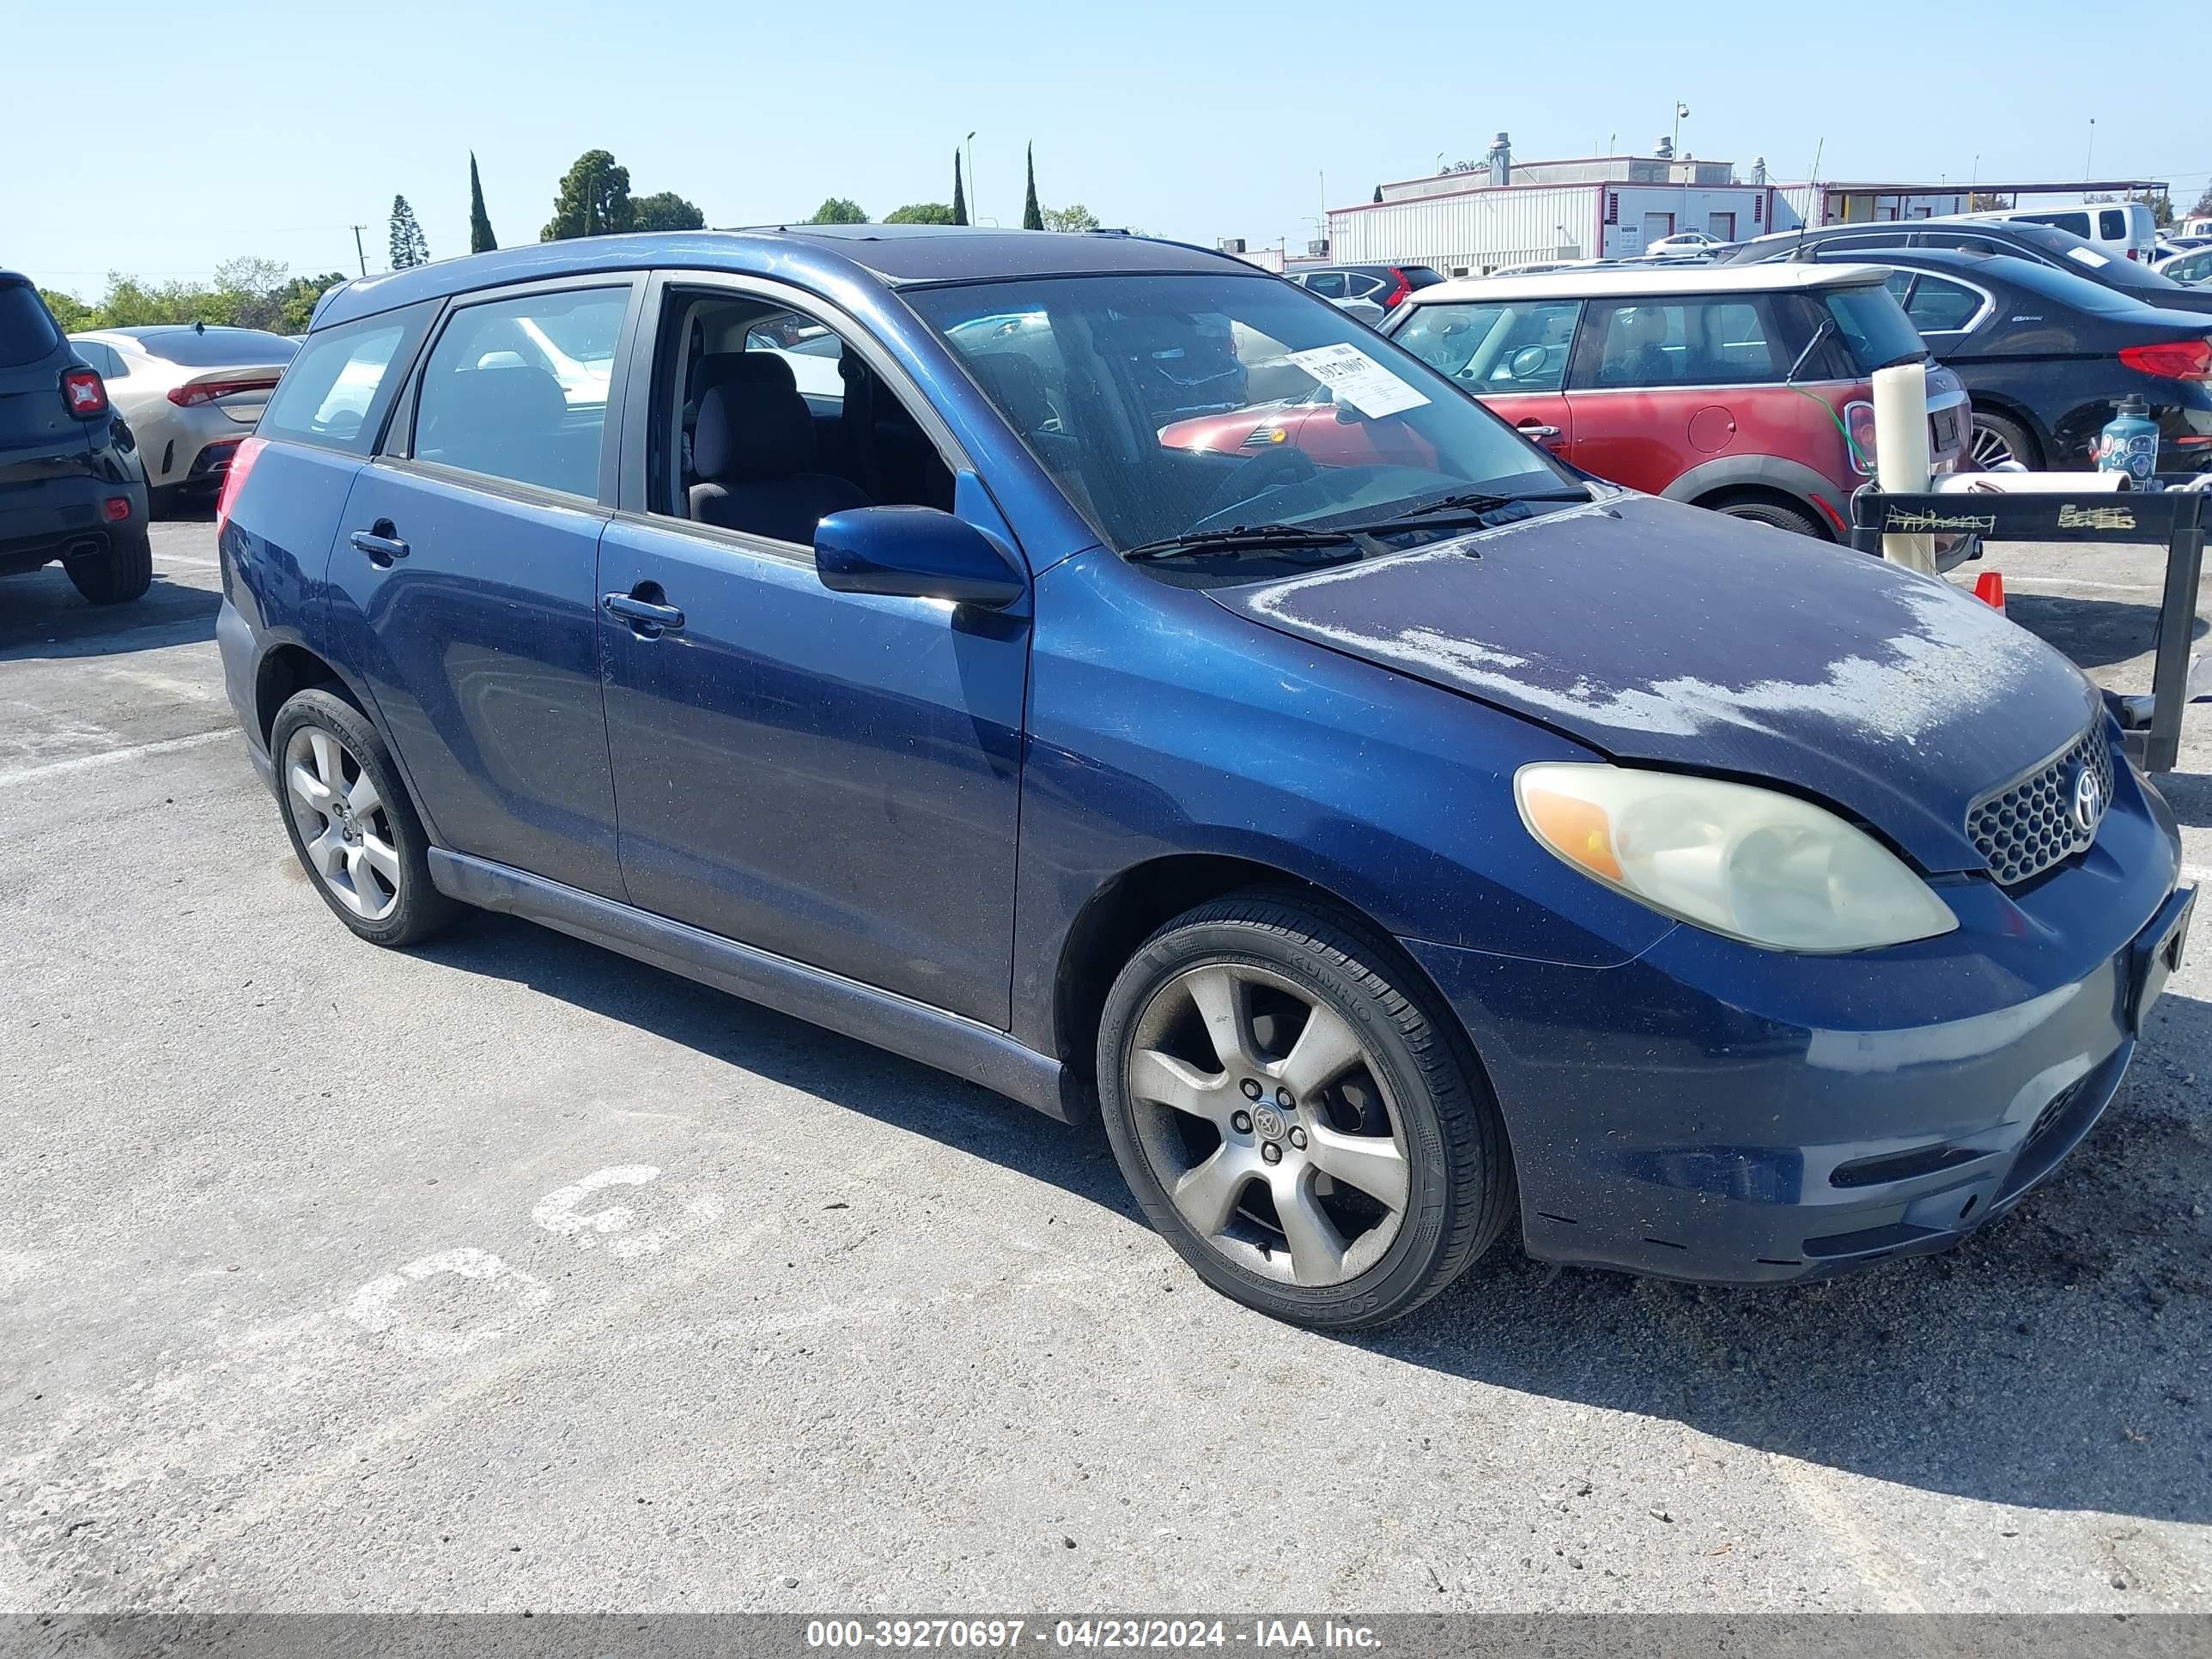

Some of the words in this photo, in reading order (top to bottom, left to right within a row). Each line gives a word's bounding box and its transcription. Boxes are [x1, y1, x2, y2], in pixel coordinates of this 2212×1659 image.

[1313, 357, 1372, 380] 39270697
[1287, 948, 1374, 1024] KUMHO
[1297, 1291, 1381, 1320] SOLUS
